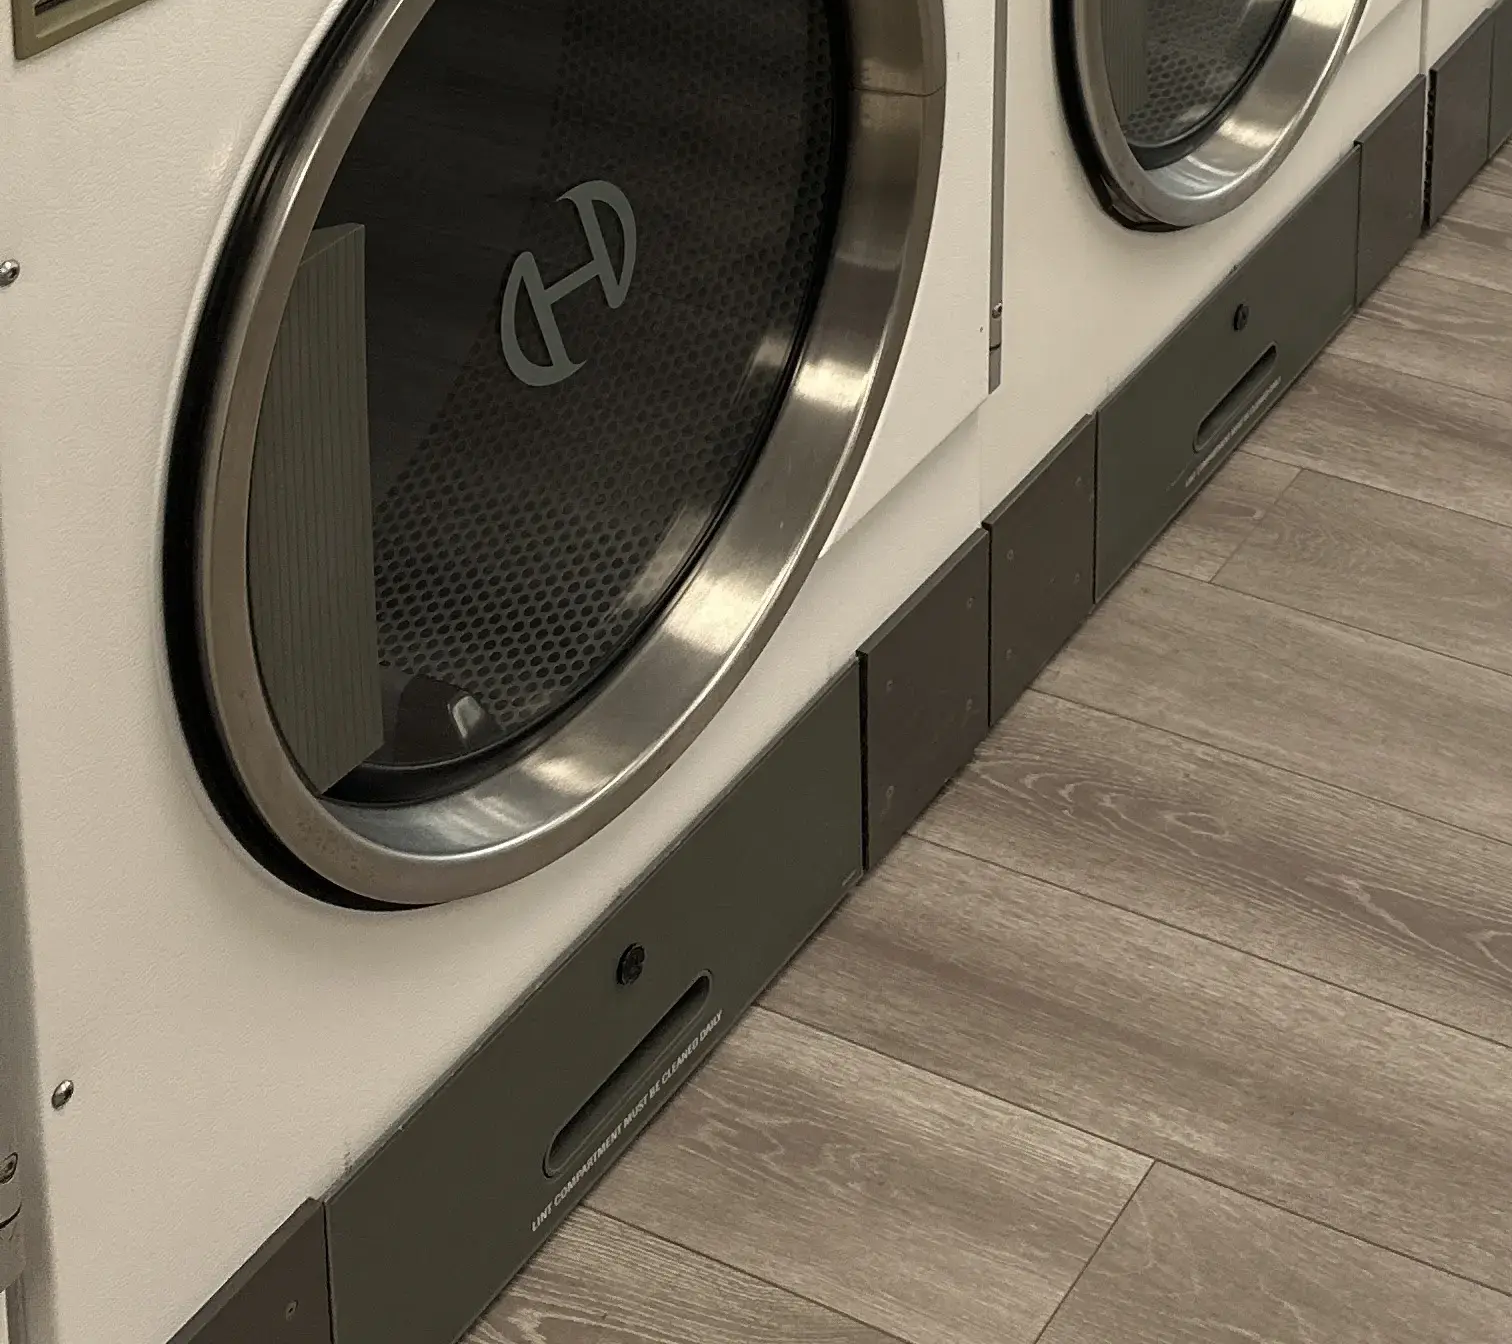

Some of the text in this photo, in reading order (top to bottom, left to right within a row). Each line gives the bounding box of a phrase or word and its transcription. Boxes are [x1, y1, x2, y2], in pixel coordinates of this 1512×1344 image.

[531, 1009, 723, 1232] LINT COMPARTMENT MUST BE CLEANED DAILY
